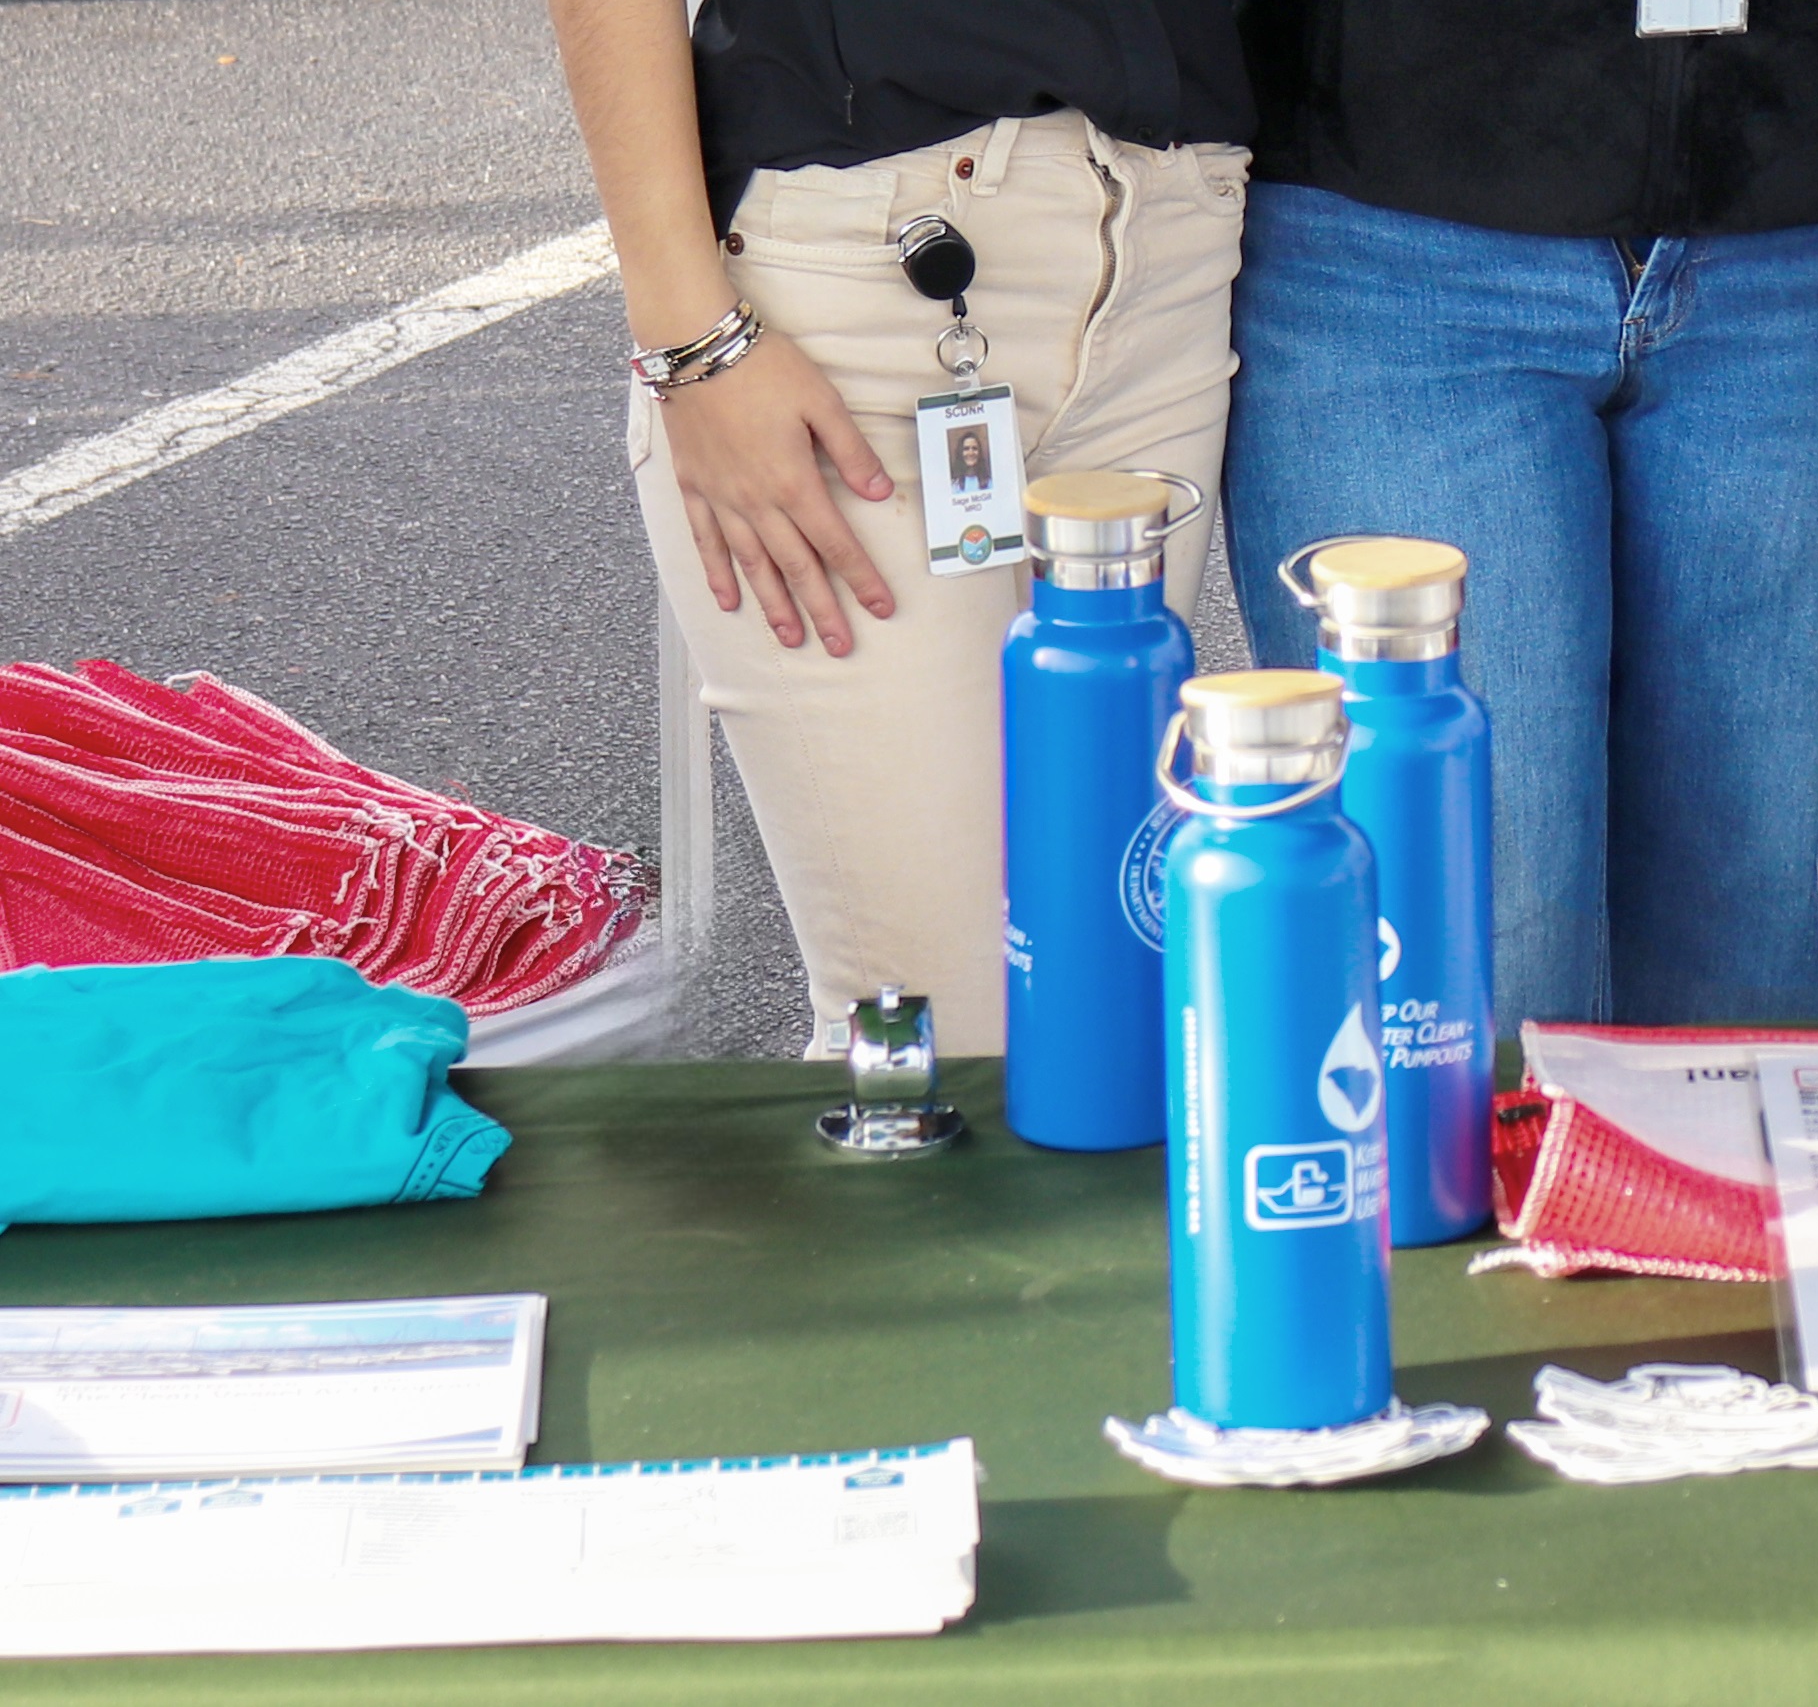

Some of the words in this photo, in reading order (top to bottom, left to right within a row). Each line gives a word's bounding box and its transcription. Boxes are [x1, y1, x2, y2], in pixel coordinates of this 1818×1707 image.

[944, 403, 985, 420] SCDNR
[1400, 998, 1440, 1022] OUR
[1382, 1026, 1414, 1047] TER
[1416, 1020, 1467, 1045] CLEAN
[1390, 1041, 1473, 1069] PUMPOUTS
